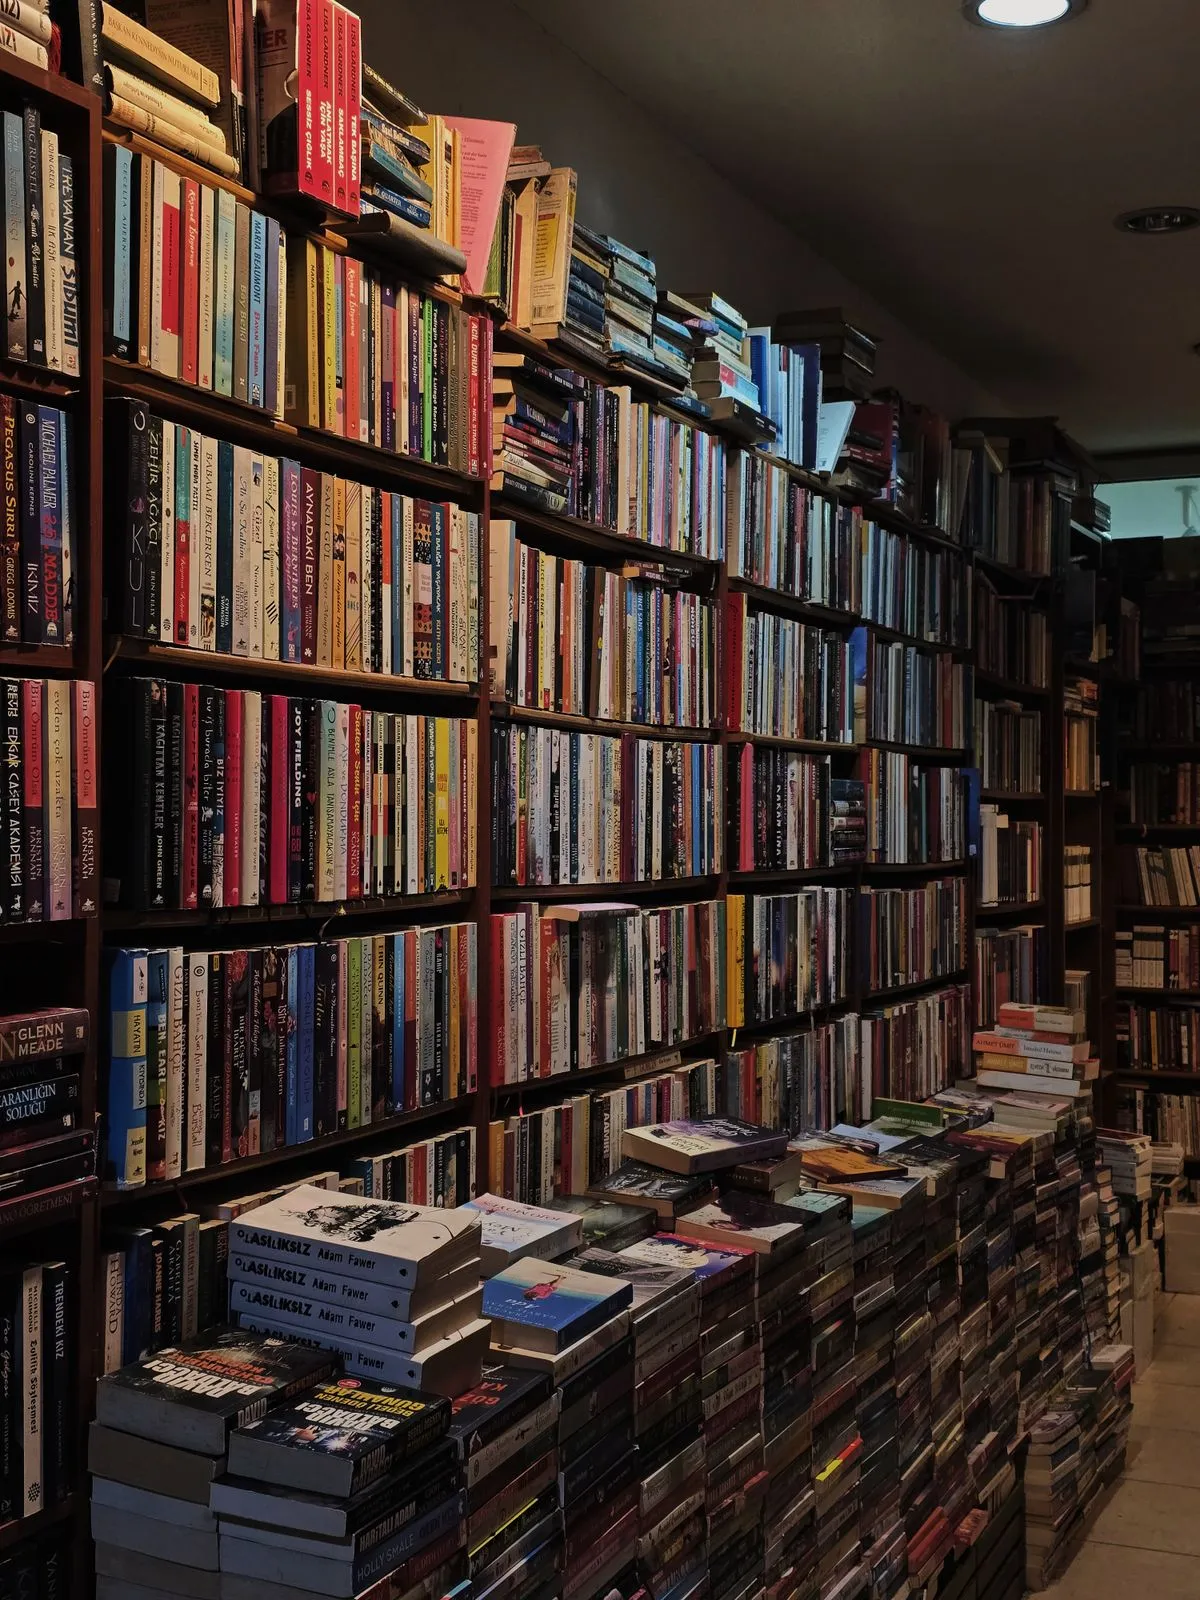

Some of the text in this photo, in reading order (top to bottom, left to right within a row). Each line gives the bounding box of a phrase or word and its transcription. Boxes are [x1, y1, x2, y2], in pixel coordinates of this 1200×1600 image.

[337, 108, 345, 178] SAKLAMBAÇ
[29, 146, 37, 194] RUSSELL
[62, 167, 75, 255] TREVANIAN
[253, 220, 262, 304] MARIA BEAUMONT
[238, 284, 246, 309] Bay
[5, 416, 16, 538] PEGASUS SIRRI
[42, 418, 56, 509] MICHAEL PALMER
[149, 431, 161, 545] ZEHİR AĞACI
[290, 471, 299, 520] LOUIS
[204, 451, 213, 577] BABAMI BEKLERKEN
[254, 505, 263, 545] Güzel
[305, 482, 315, 595] AYNADAKİ BEN
[6, 557, 16, 620] GREGG LOOMIS
[44, 553, 57, 621] MADDE
[206, 697, 213, 712] bu
[8, 727, 20, 768] EDGAR
[31, 685, 40, 796] Bin Ömrüm Olsa
[53, 691, 63, 819] evden çok uzakta
[82, 690, 91, 798] Bin Ömrüm Olsa
[204, 729, 214, 769] burada
[9, 773, 20, 814] CASEY
[154, 782, 164, 829] KENTLER
[203, 773, 212, 801] biter
[18, 1022, 64, 1041] GLENN
[18, 1037, 64, 1057] MEADE
[133, 1015, 141, 1053] HAYATIN
[157, 1014, 166, 1085] BEN, EARL
[317, 1247, 343, 1263] Adam
[349, 1254, 376, 1270] Fawer
[108, 1258, 120, 1334] HOWARD
[115, 1273, 123, 1314] LINDA
[154, 1252, 163, 1333] JOANNE HARRIS
[312, 1278, 337, 1294] Adam
[342, 1285, 369, 1301] Fawer
[55, 1281, 66, 1360] TRENDEKİ KIZ
[318, 1309, 344, 1325] Adam
[349, 1316, 376, 1332] Fawer
[142, 1360, 261, 1396] BALDACCI
[357, 1354, 384, 1370] Fawer
[238, 1398, 268, 1428] DAVID
[294, 1402, 400, 1429] BALDACCI
[394, 1501, 416, 1530] ADAM
[357, 1533, 415, 1582] HOLLY SMALE
